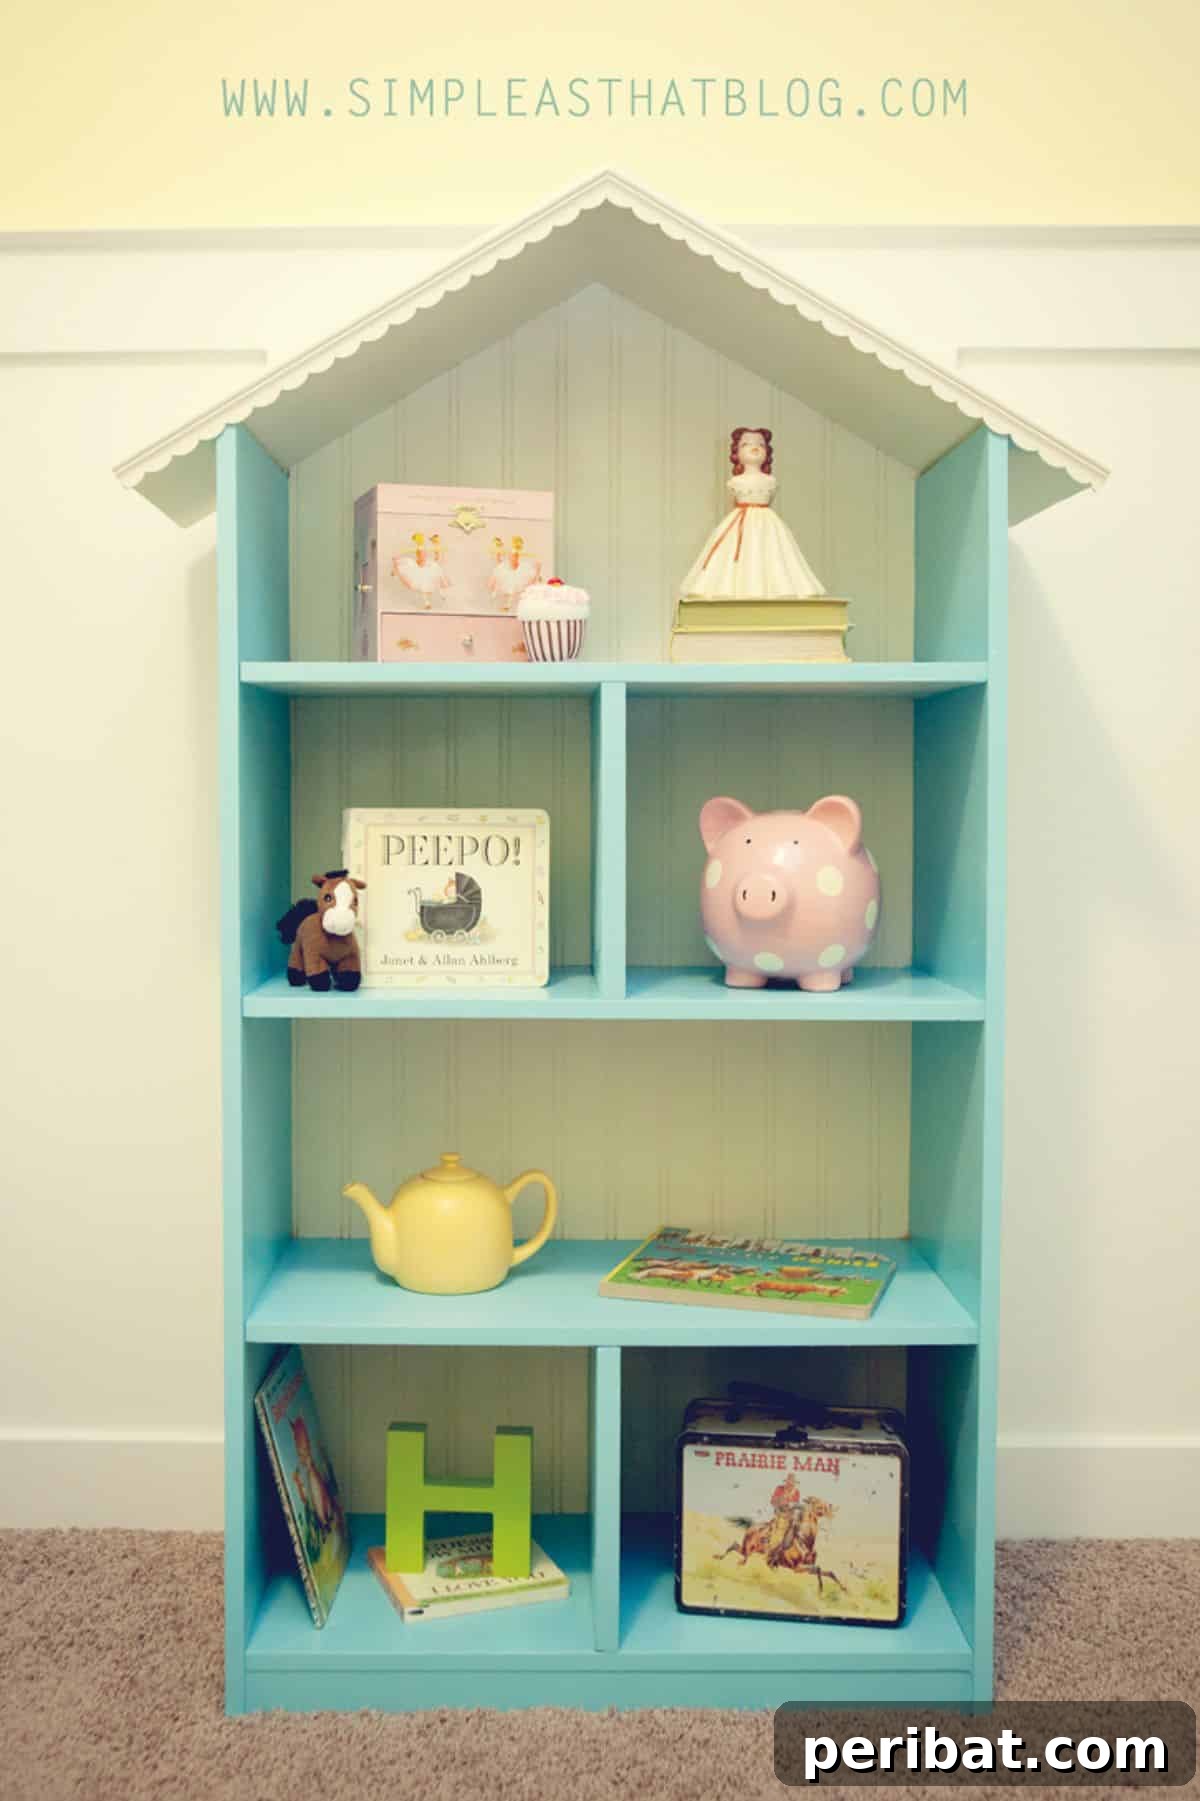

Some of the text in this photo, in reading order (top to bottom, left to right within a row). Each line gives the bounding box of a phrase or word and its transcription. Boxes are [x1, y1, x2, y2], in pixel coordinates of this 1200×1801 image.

[381, 834, 521, 867] PEEPO!
[380, 953, 519, 968] Janet & Allan Ahlberg
[714, 1452, 787, 1471] PRAIRIE
[792, 1456, 841, 1474] MAN
[386, 1422, 533, 1579] H
